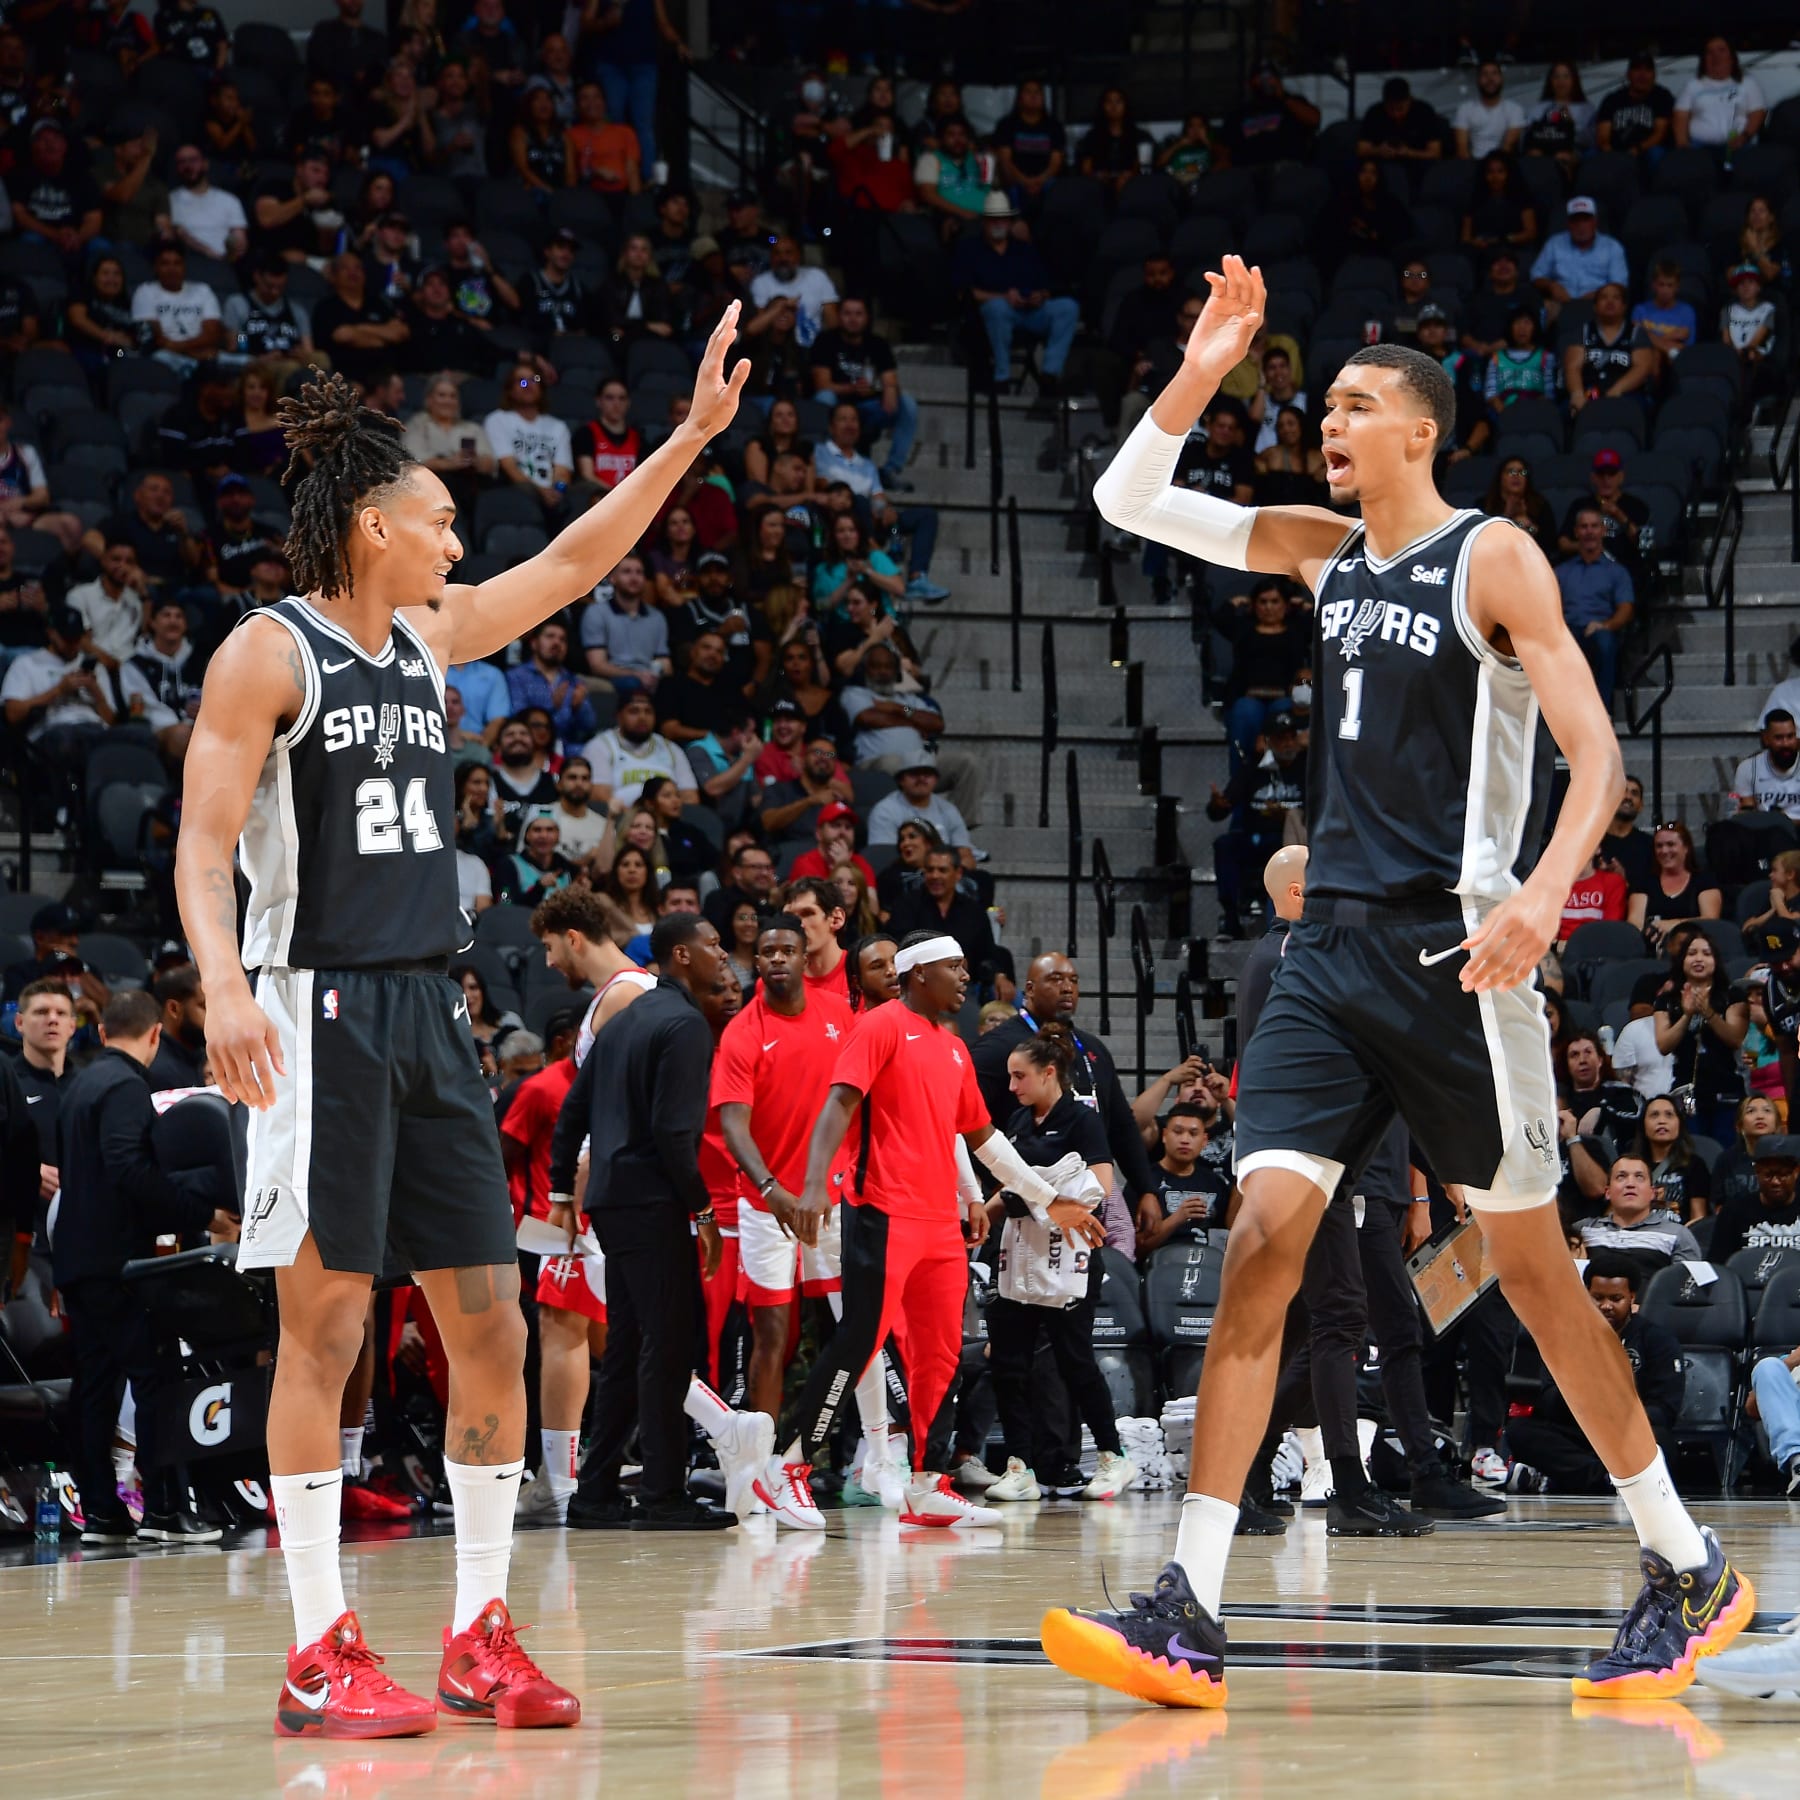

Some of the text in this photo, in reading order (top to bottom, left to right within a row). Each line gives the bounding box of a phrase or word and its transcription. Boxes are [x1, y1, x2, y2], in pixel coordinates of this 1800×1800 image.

[1320, 598, 1441, 662] SPURS
[323, 702, 446, 770] SPURS
[1338, 667, 1364, 741] 1
[355, 777, 445, 856] 24
[1567, 890, 1604, 908] ASO
[1048, 1229, 1063, 1270] ADE
[188, 1381, 232, 1447] G
[810, 1369, 851, 1443] HOUSTON ROCKETS
